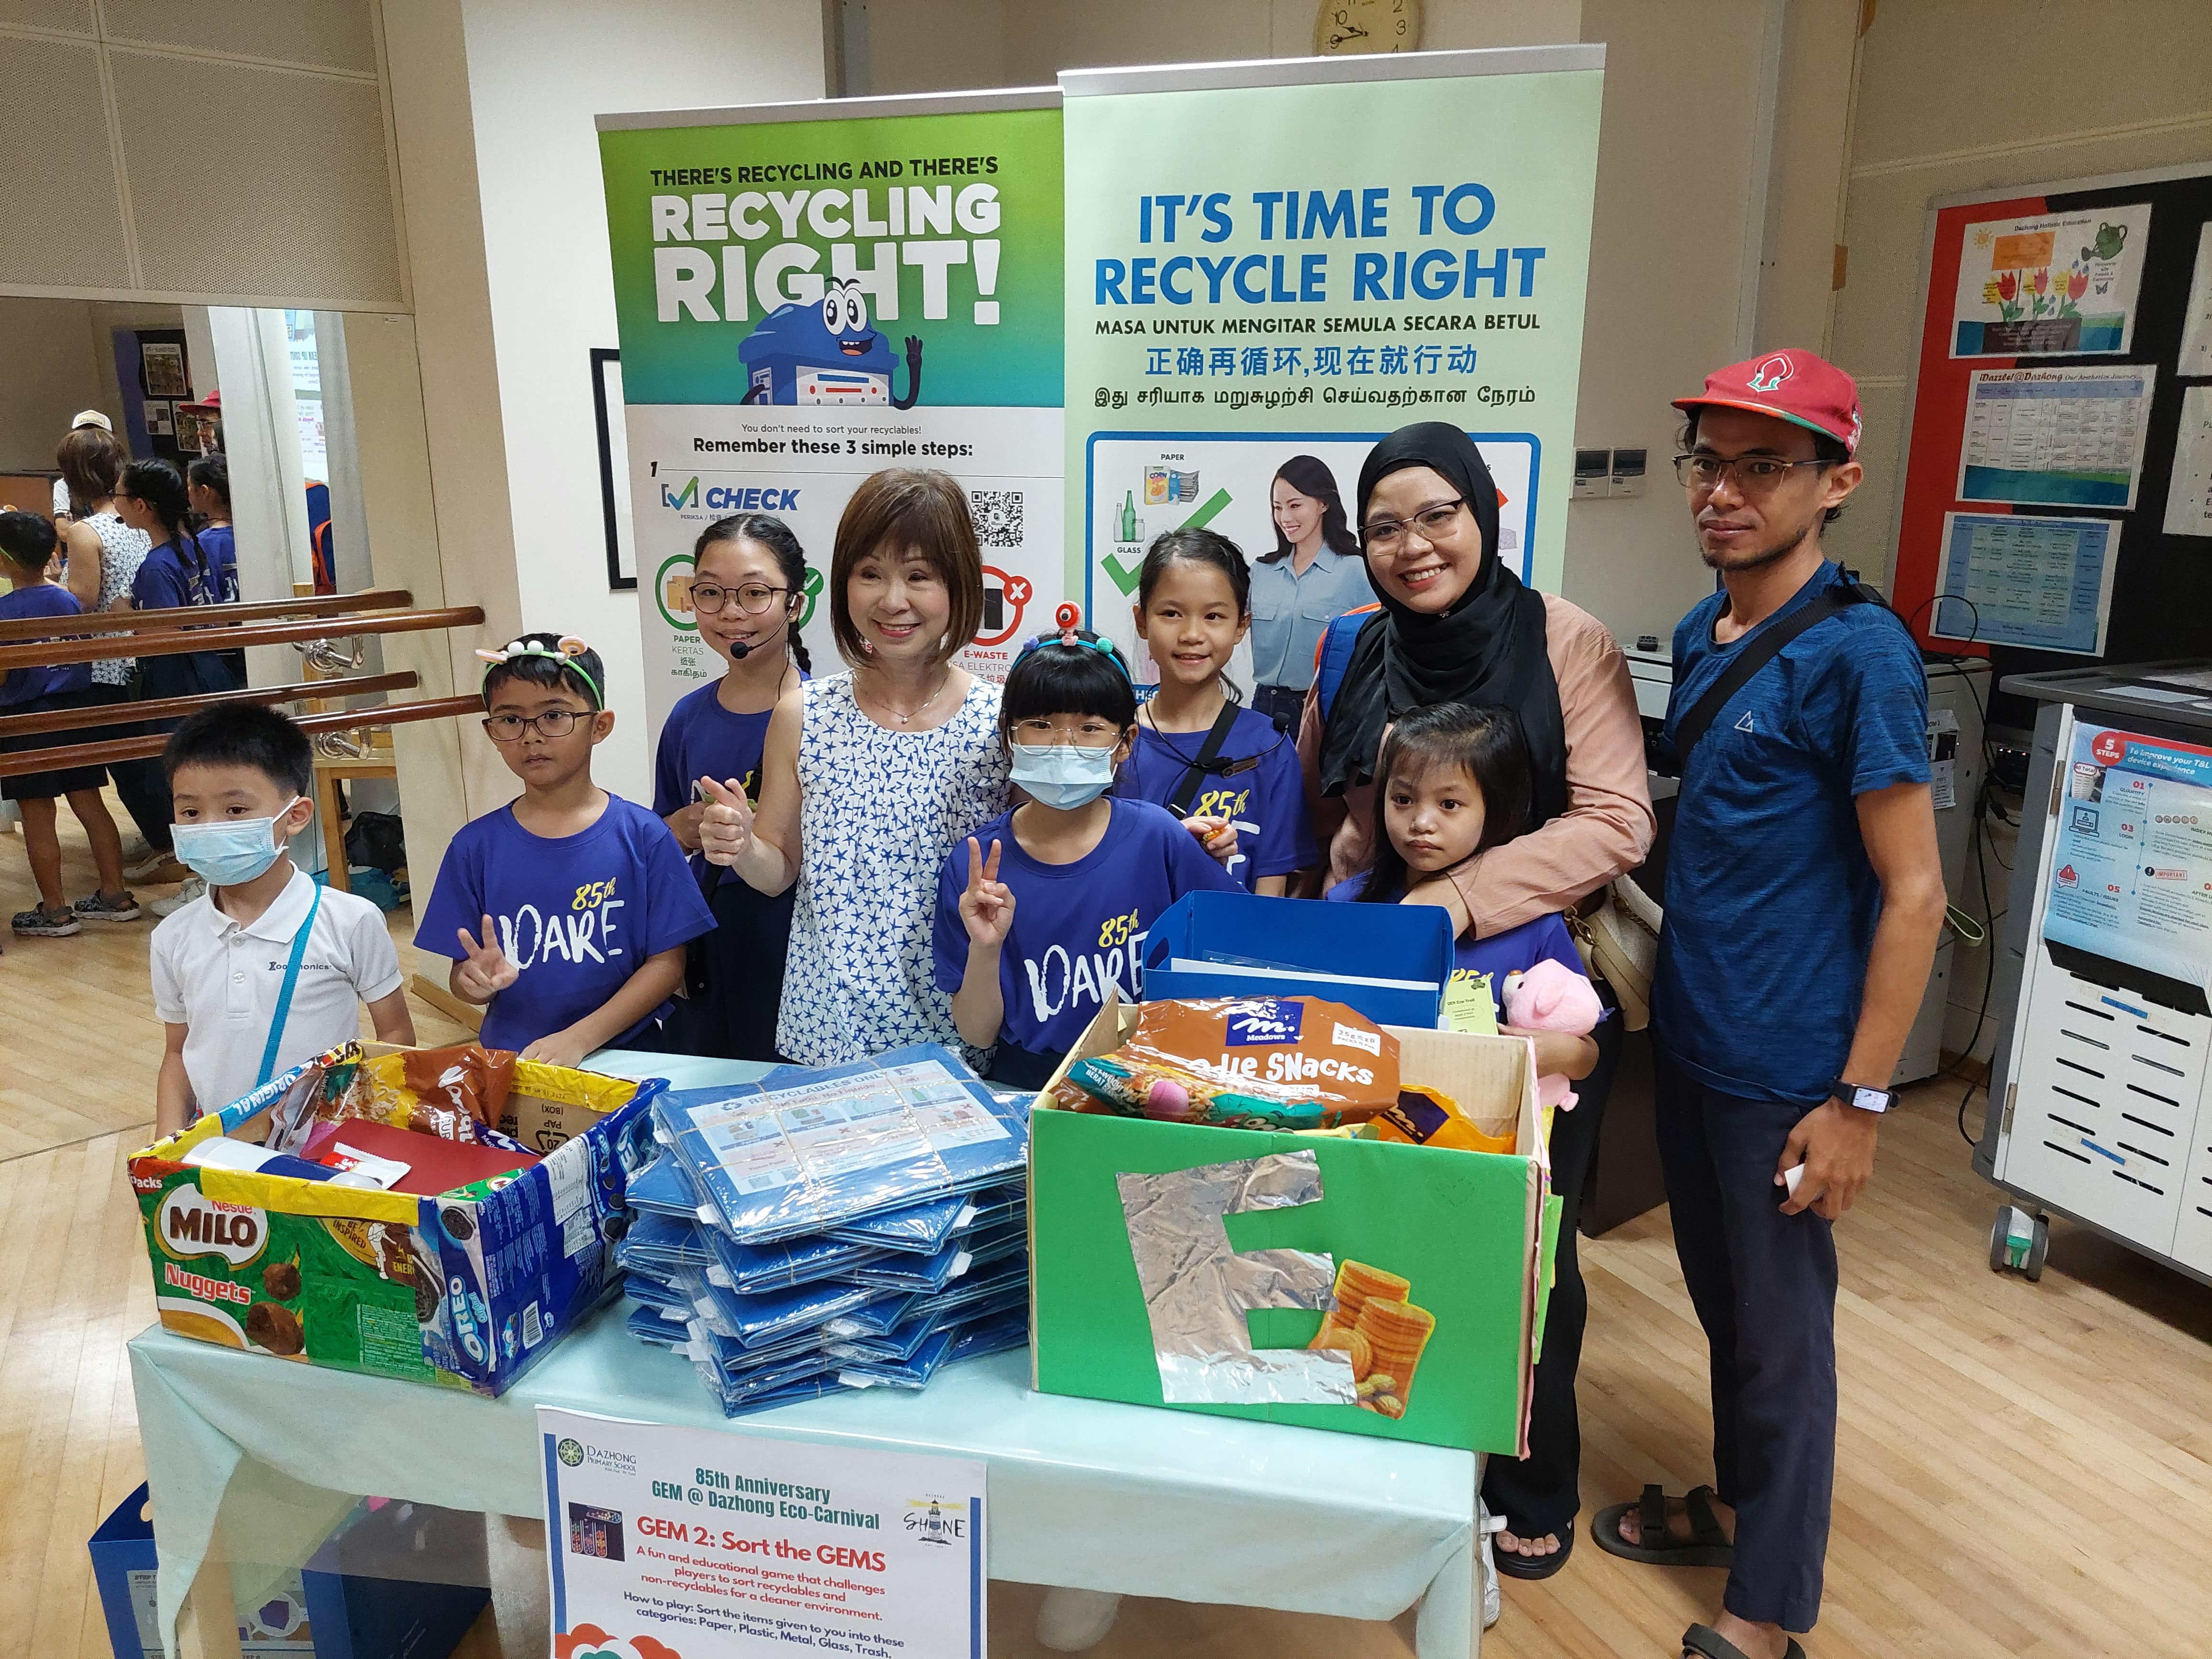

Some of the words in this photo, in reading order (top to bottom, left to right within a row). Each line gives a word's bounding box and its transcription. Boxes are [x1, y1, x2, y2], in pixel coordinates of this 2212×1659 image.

[1333, 10, 1348, 26] 10
[1396, 19, 1406, 36] 3
[650, 166, 732, 186] THERE'S
[738, 162, 853, 183] RECYCLING
[859, 160, 904, 179] AND
[908, 156, 998, 176] THERE'S
[651, 183, 1001, 242] RECYCLING
[1252, 188, 1390, 241] TIME
[1411, 182, 1496, 236] TO
[653, 239, 1001, 325] RIGHT!
[1095, 254, 1328, 306] RECYCLE
[1352, 247, 1546, 302] RIGHT
[1095, 319, 1146, 335] MASA
[1152, 319, 1216, 334] UNTUK
[1221, 318, 1316, 334] MENGITAR
[1322, 316, 1396, 333] SEMULA
[1402, 315, 1477, 332] SECARA
[1483, 313, 1541, 330] BETUL
[1094, 388, 1128, 409] இது
[1136, 388, 1205, 406] சரியாக
[1476, 385, 1536, 408] நேரம்
[741, 424, 759, 432] You
[761, 424, 785, 433] don't
[786, 424, 810, 433] need
[812, 425, 823, 434] to
[826, 425, 845, 434] sort
[846, 426, 868, 436] your
[870, 424, 922, 436] recyclables!
[693, 438, 787, 454] Remember
[791, 438, 841, 455] these
[845, 439, 856, 454] 3
[861, 438, 917, 458] simple
[921, 441, 974, 459] steps:
[650, 461, 658, 477] 1
[706, 486, 802, 511] CHECK
[672, 645, 704, 655] KERTAS
[674, 635, 701, 644] PAPER
[963, 650, 1008, 660] E-WASTE
[968, 662, 1012, 672] ELEKTRO
[2096, 749, 2120, 759] STEPS
[2104, 738, 2115, 750] 5
[2127, 756, 2151, 766] device
[2172, 756, 2191, 765] your
[2133, 781, 2145, 790] 01
[2121, 823, 2134, 832] 03
[571, 876, 617, 910] 85th
[2107, 884, 2121, 893] 05
[498, 900, 625, 973] DARE
[1098, 908, 1139, 948] 85th
[1246, 1033, 1286, 1041] Meadows
[1085, 1069, 1106, 1086] BERAT
[748, 1079, 851, 1104] RECYCLABLES
[839, 1084, 875, 1096] Liquids
[541, 1103, 564, 1116] (BOX)
[543, 1120, 562, 1129] PAP
[170, 1206, 257, 1248] MILO
[332, 1220, 366, 1249] INSPIRED
[165, 1262, 251, 1305] Nuggets
[450, 1276, 485, 1363] OREO
[586, 1445, 636, 1464] DAZHONG
[587, 1455, 613, 1468] PRIMARY
[613, 1461, 637, 1472] SCHOOL
[695, 1467, 730, 1490] 85th
[735, 1475, 831, 1505] Anniversary
[652, 1480, 683, 1501] GEM
[687, 1487, 704, 1506] @
[708, 1490, 774, 1518] Dazhong
[780, 1501, 880, 1530] Eco-Carnival
[637, 1515, 689, 1543] GEM
[693, 1526, 716, 1548] 2:
[721, 1531, 771, 1556] Sort
[774, 1538, 812, 1561] the
[816, 1544, 887, 1573] GEMS
[636, 1545, 646, 1556] A
[647, 1547, 666, 1560] fun
[668, 1551, 690, 1565] and
[692, 1557, 759, 1576] educational
[761, 1569, 795, 1582] game
[797, 1572, 822, 1586] that
[823, 1576, 886, 1596] challenges
[674, 1566, 717, 1584] players
[718, 1573, 731, 1584] to
[732, 1575, 755, 1589] sort
[757, 1581, 821, 1599] recyclables
[822, 1589, 846, 1603] and
[641, 1573, 729, 1597] non-recyclables
[730, 1586, 748, 1600] for
[749, 1593, 758, 1601] a
[759, 1593, 803, 1608] cleaner
[804, 1600, 884, 1621] environment.
[623, 1591, 651, 1604] How
[652, 1596, 664, 1607] to
[665, 1598, 695, 1614] play:
[696, 1603, 721, 1617] Sort
[722, 1607, 741, 1621] the
[742, 1611, 774, 1626] items
[775, 1617, 809, 1632] given
[809, 1622, 822, 1633] to
[823, 1626, 846, 1641] you
[848, 1628, 872, 1644] into
[873, 1633, 905, 1649] these
[636, 1607, 697, 1626] categories:
[699, 1617, 737, 1635] Paper,
[739, 1623, 778, 1642] Plastic,
[780, 1630, 817, 1648] Metal,
[818, 1637, 853, 1655] Glass,
[855, 1643, 893, 1659] Trash.
